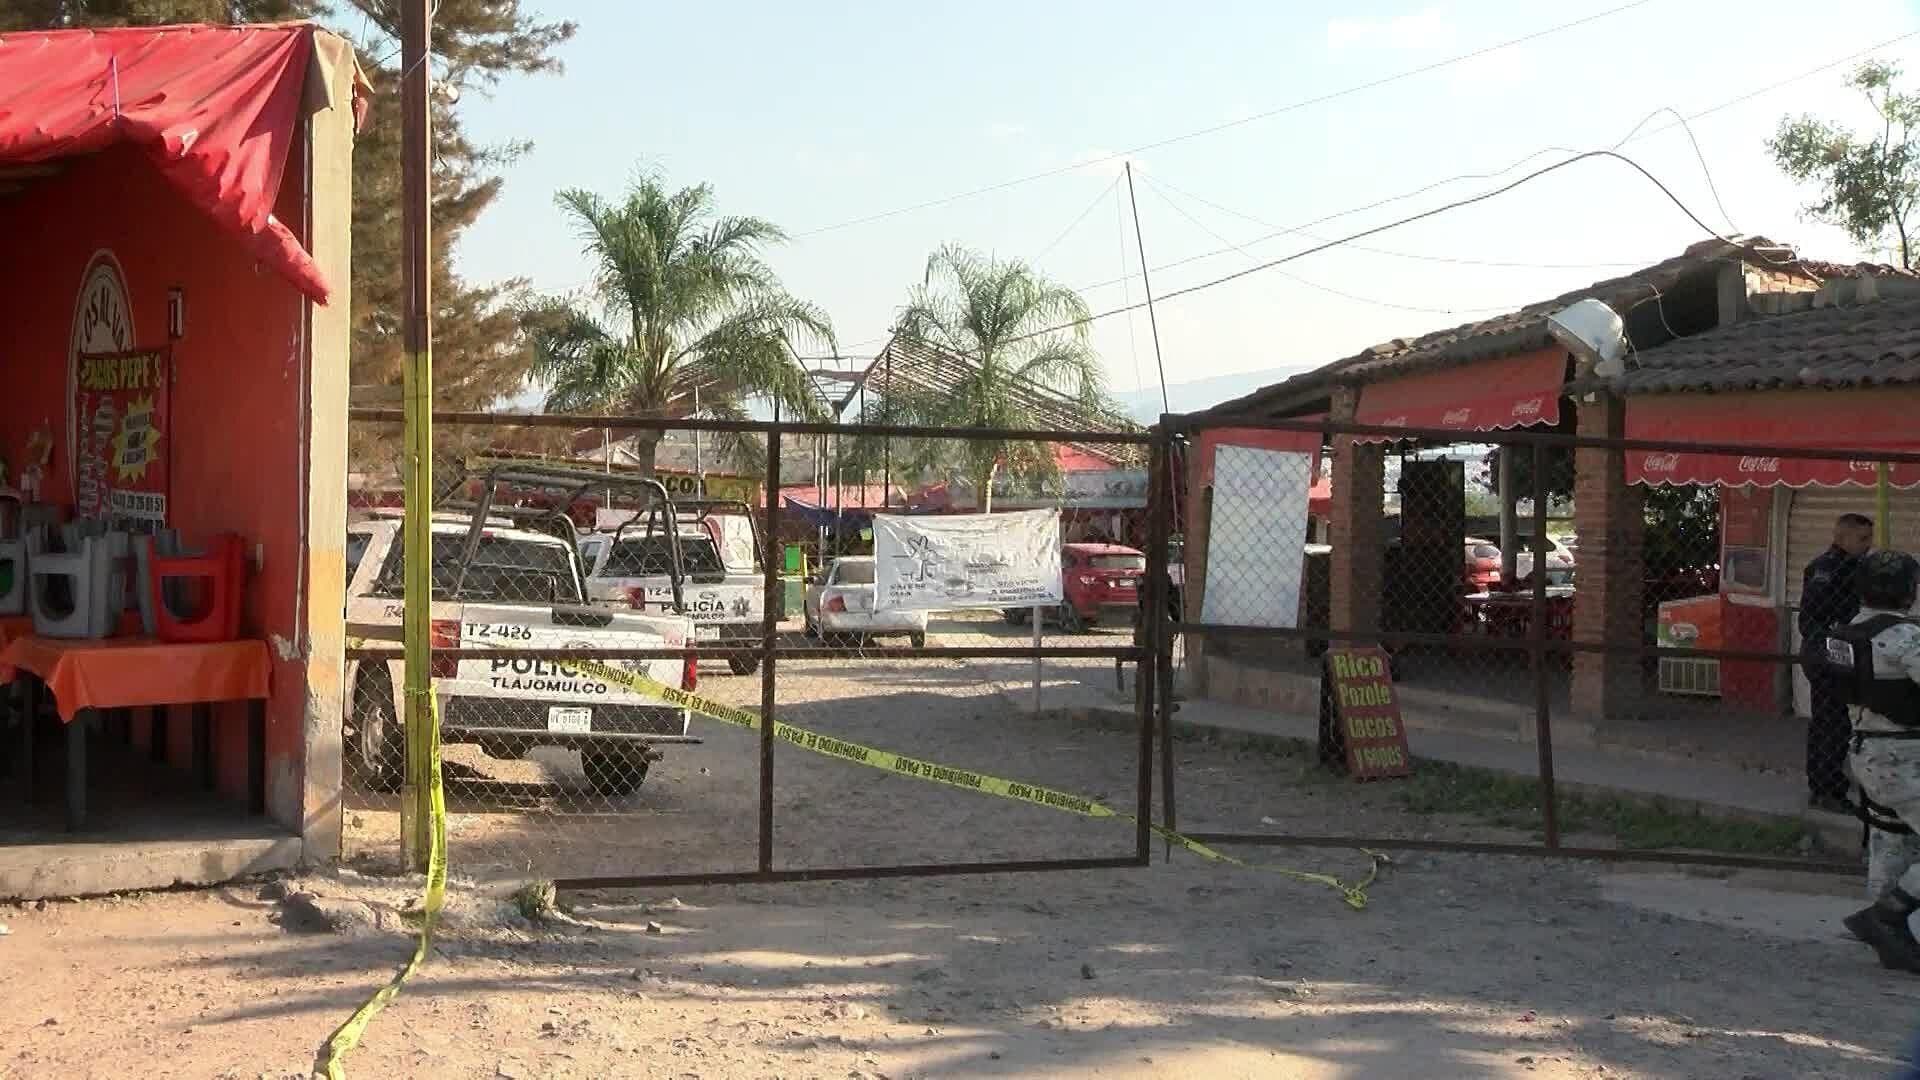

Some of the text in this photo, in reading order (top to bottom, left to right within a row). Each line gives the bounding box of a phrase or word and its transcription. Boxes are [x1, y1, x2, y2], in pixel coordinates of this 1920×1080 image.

[466, 623, 532, 640] TZ-426
[1333, 653, 1384, 678] Rico
[491, 677, 607, 694] TLAJOMULCO
[1338, 681, 1392, 707] Pozole
[664, 686, 753, 726] PROHIBIDO EL PASO
[777, 725, 868, 761] PROHIBIDO EL PASO
[895, 757, 981, 788] PROHIBIDO EL PASO
[1008, 783, 1092, 812] PROHIBIDO EL PASO
